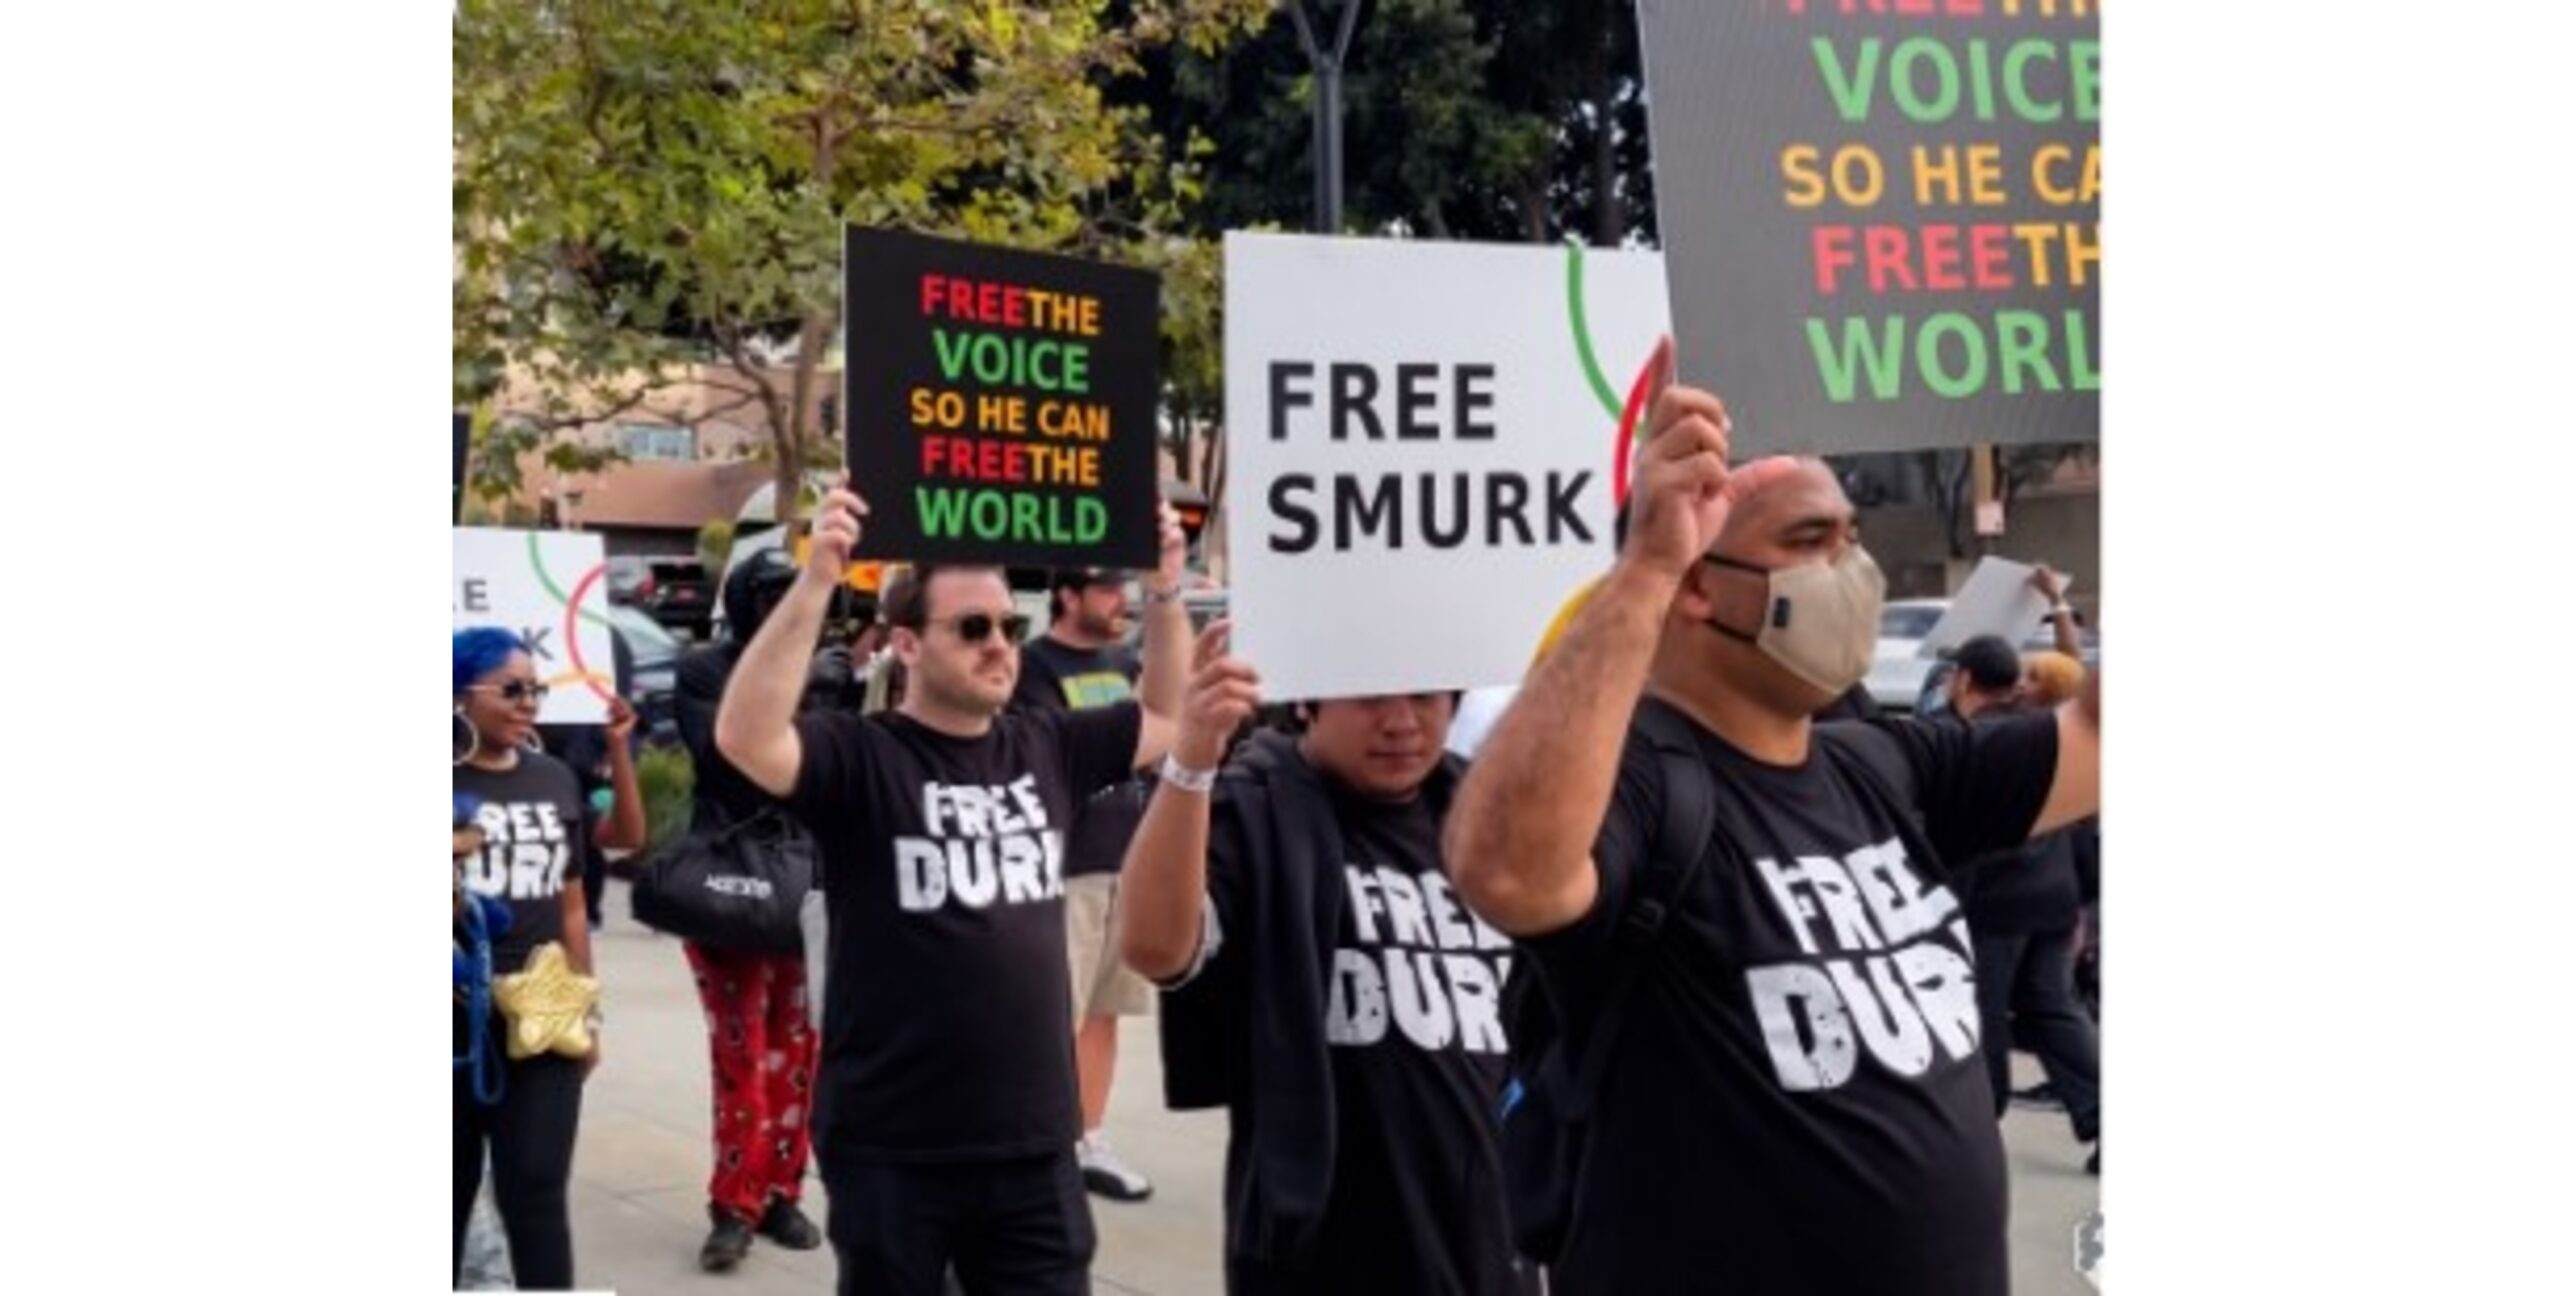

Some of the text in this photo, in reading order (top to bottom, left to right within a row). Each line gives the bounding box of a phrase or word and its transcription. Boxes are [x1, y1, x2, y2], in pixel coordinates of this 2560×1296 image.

[1780, 145, 1884, 206] SO
[1911, 145, 2006, 205] HE
[933, 329, 1089, 392] VOICE
[911, 388, 1109, 438] SO HE CAN
[1268, 360, 1495, 440] FREE
[916, 486, 1107, 543] WORLD
[1267, 470, 1595, 553] SMURK
[476, 802, 565, 842] REE
[924, 773, 1047, 837] FREE
[1326, 948, 1511, 1054] DUR
[1745, 918, 1980, 1091] DUR
